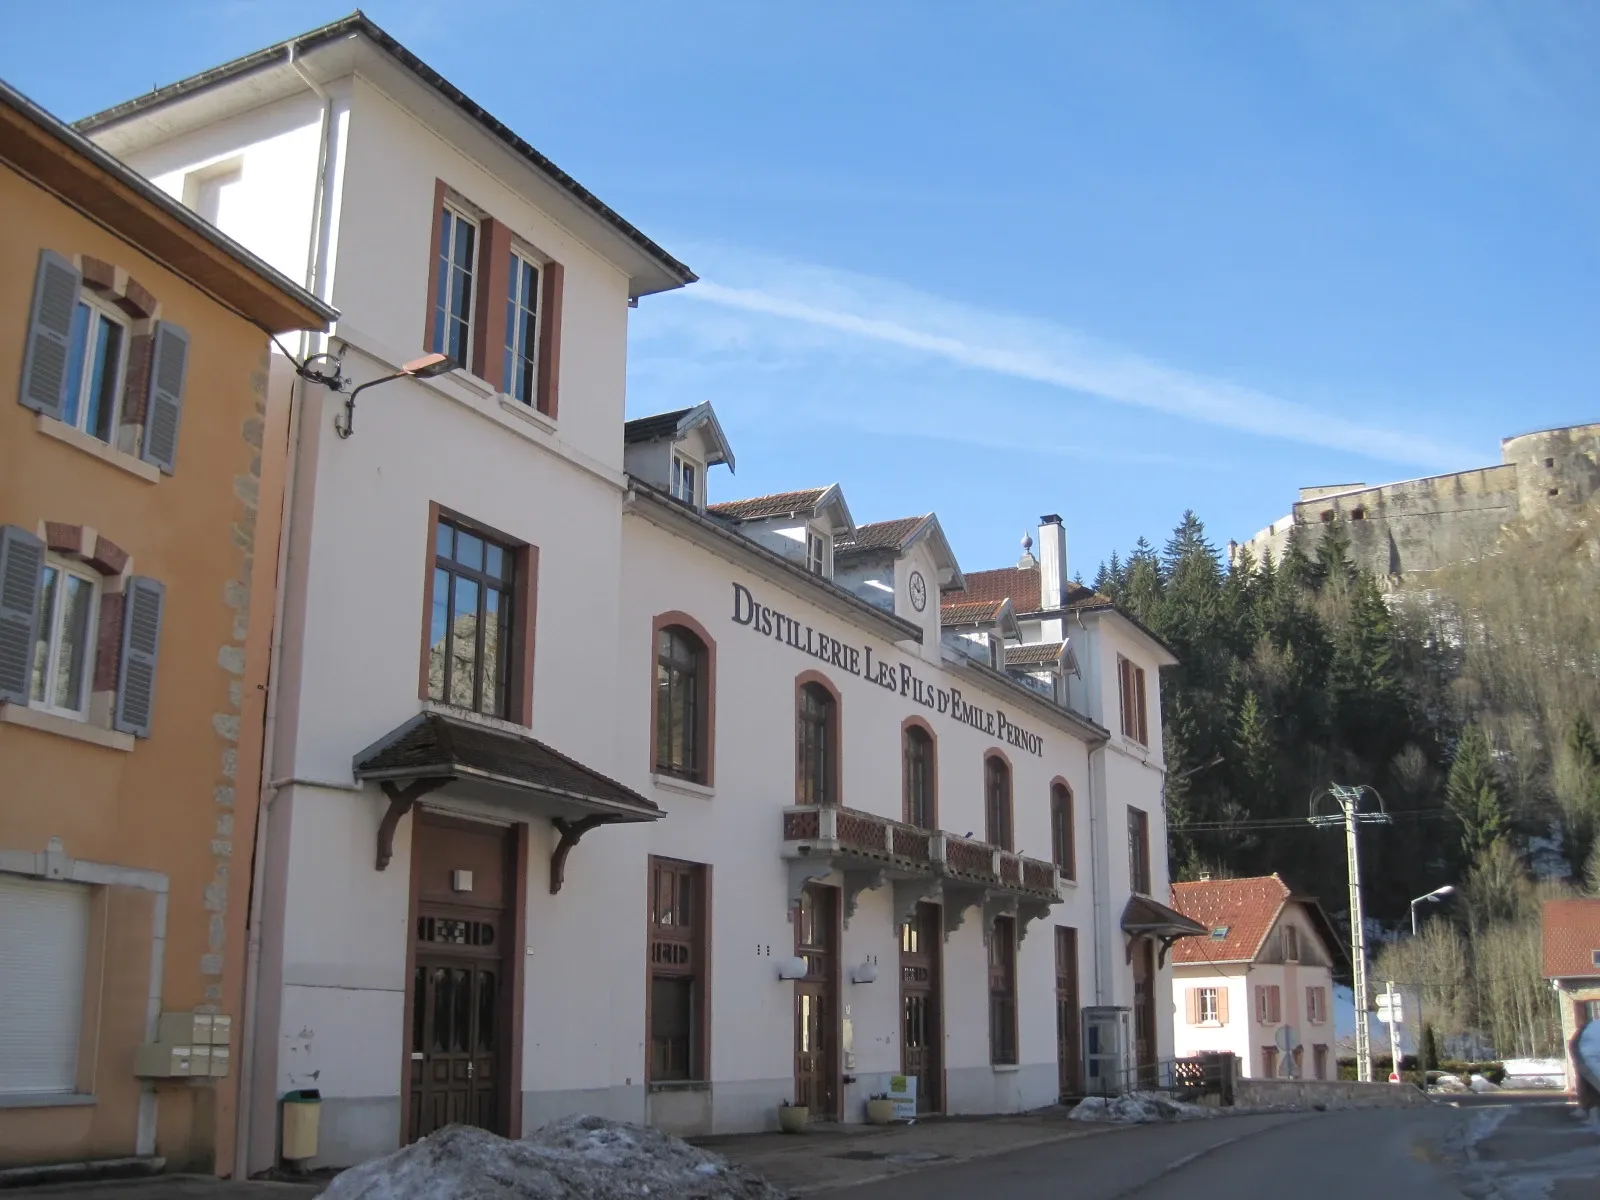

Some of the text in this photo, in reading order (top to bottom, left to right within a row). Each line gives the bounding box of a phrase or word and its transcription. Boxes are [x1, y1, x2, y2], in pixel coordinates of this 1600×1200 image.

[732, 581, 860, 676] DISTILLERIE
[864, 645, 897, 692] LES
[899, 662, 935, 709] FILS
[997, 709, 1043, 757] PERNOT
